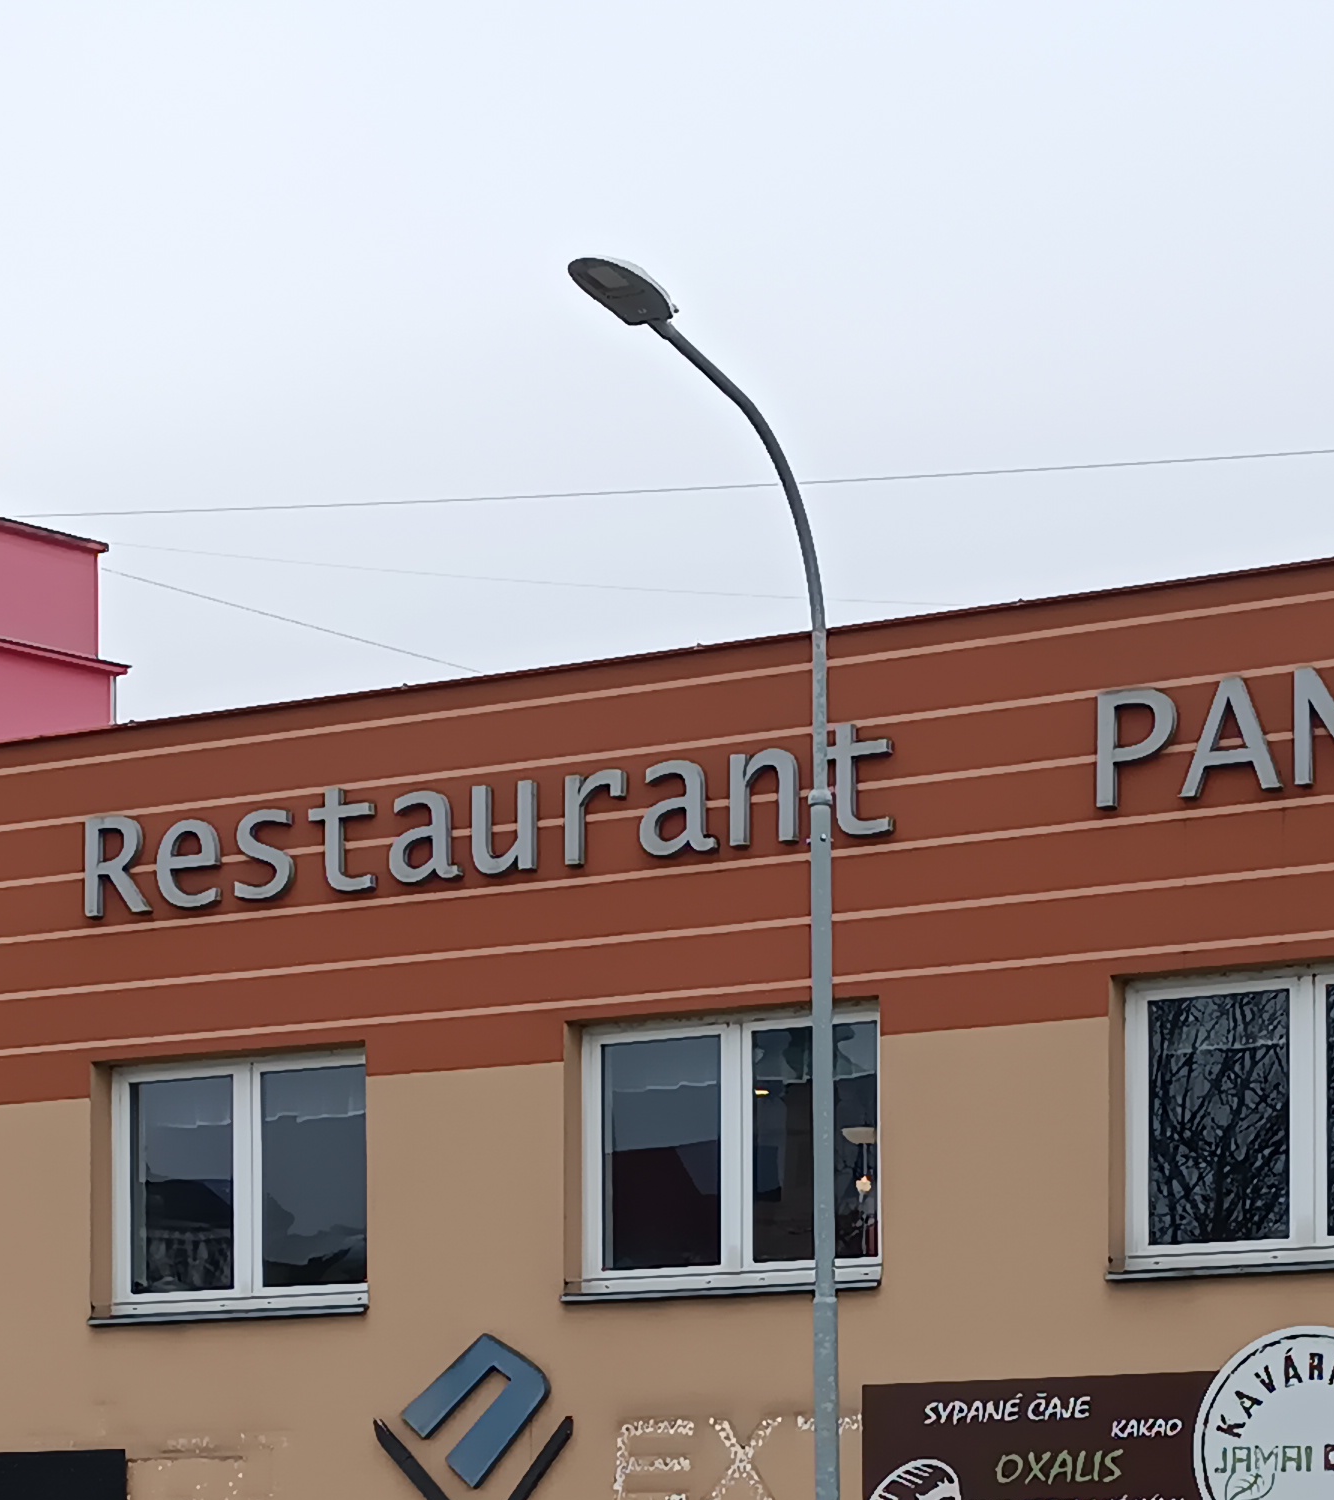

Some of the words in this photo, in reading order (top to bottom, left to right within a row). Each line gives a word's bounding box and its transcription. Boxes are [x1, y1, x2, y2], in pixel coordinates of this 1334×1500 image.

[83, 723, 895, 918] Restaurant
[924, 1393, 1023, 1425] SYPANÉ
[1027, 1393, 1091, 1421] ČAJE
[1111, 1418, 1183, 1438] KAKAO
[995, 1449, 1124, 1485] OXALIS
